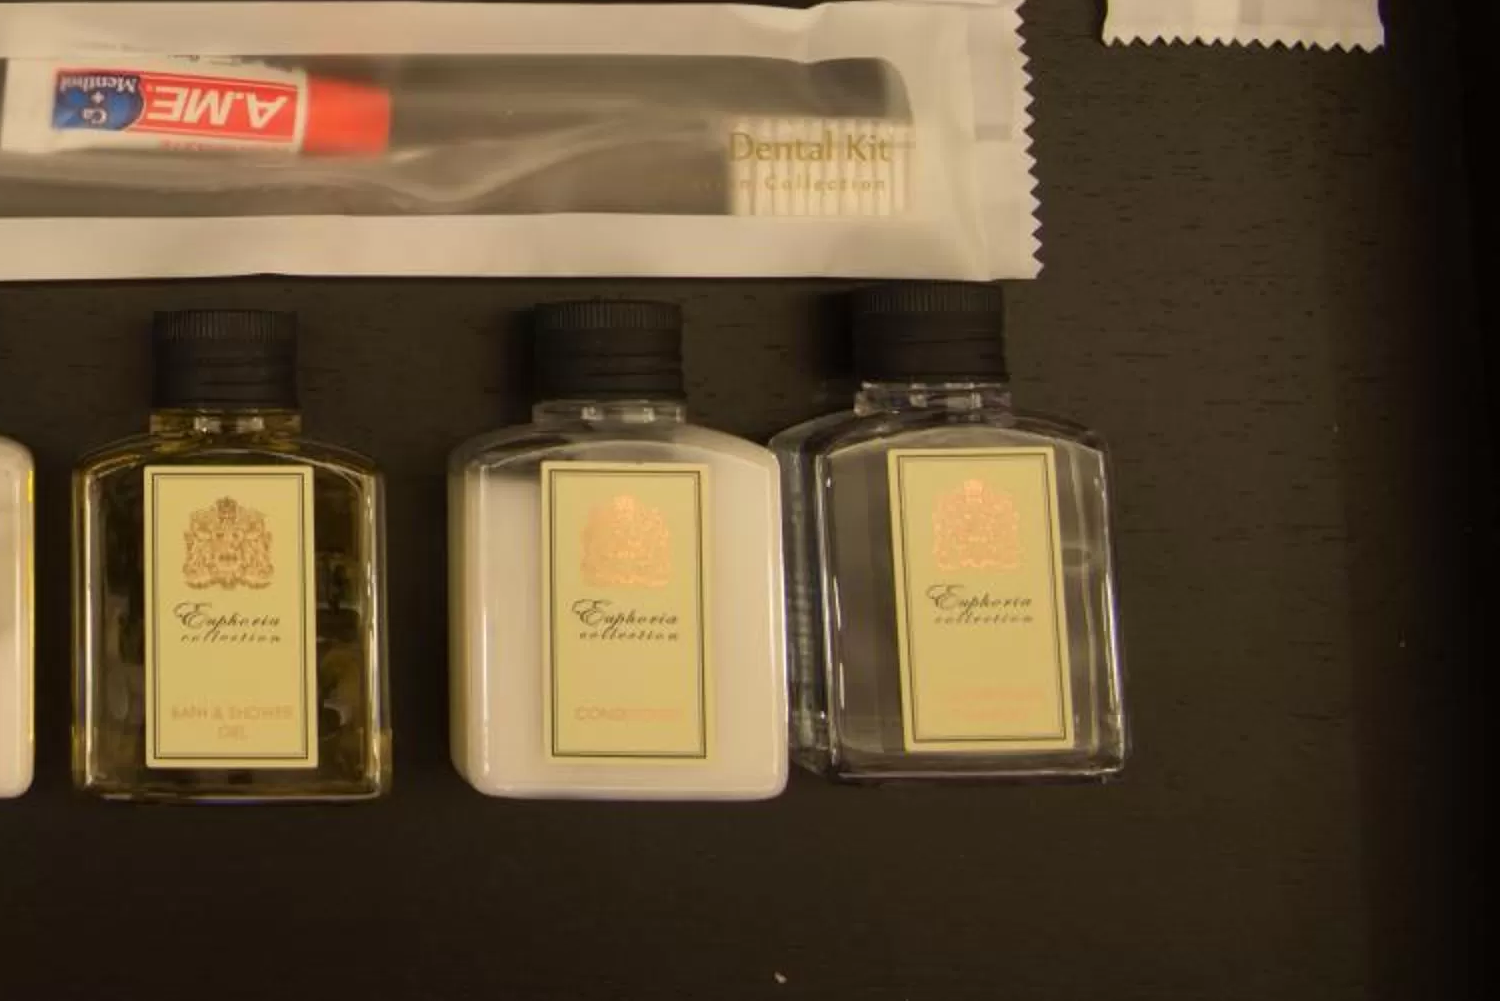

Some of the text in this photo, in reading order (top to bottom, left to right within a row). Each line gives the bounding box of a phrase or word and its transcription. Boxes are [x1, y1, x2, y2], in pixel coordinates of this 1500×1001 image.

[81, 106, 108, 125] Ca
[729, 130, 891, 163] Dental Kit
[763, 173, 886, 192] Collection
[925, 584, 1033, 620] Euphoria
[172, 601, 281, 637] Euphoria
[571, 598, 678, 635] Euphoria
[934, 611, 1034, 626] collection
[180, 630, 281, 644] collection
[579, 626, 679, 642] collection
